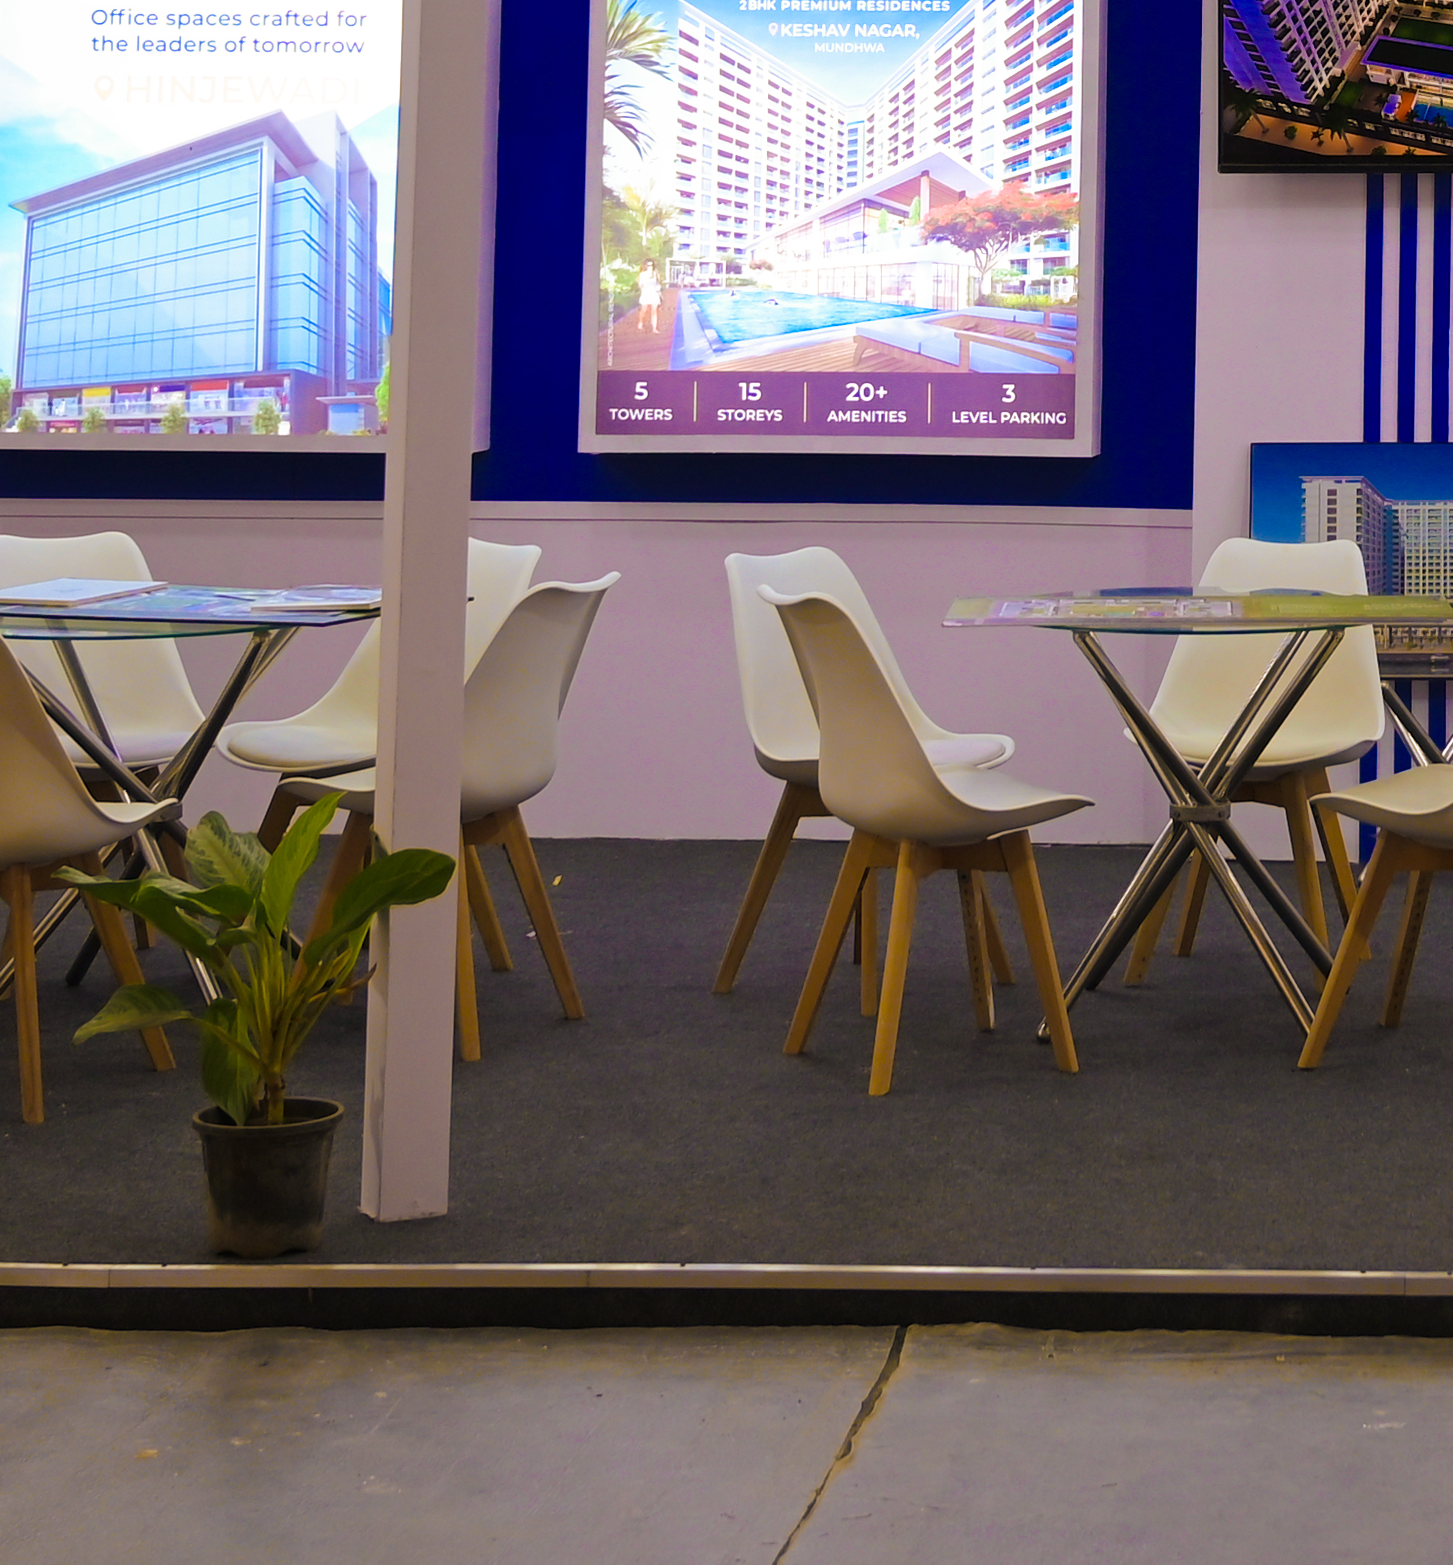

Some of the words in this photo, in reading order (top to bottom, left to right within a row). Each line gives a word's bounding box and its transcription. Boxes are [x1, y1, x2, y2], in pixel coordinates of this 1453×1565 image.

[739, 0, 776, 10] 2BHK
[857, 0, 950, 11] RESIDENCES
[92, 9, 158, 25] Office
[166, 14, 242, 29] spaces
[250, 10, 328, 26] crafted
[338, 11, 366, 26] for
[781, 23, 851, 38] KESHAV
[854, 23, 920, 40] NAGAR,
[92, 36, 128, 51] the
[137, 36, 216, 52] leaders
[225, 36, 246, 52] of
[253, 39, 364, 53] tomorrow
[814, 43, 885, 54] MUNDHWA
[635, 382, 648, 400] 5
[739, 383, 761, 401] 15
[846, 383, 887, 401] 20+
[1002, 384, 1015, 402] 3
[609, 409, 672, 420] TOWERS
[718, 409, 782, 421] STOREYS
[827, 411, 906, 422] AMENITIES
[952, 411, 997, 423] LEVEL
[1001, 412, 1066, 424] PARKING
